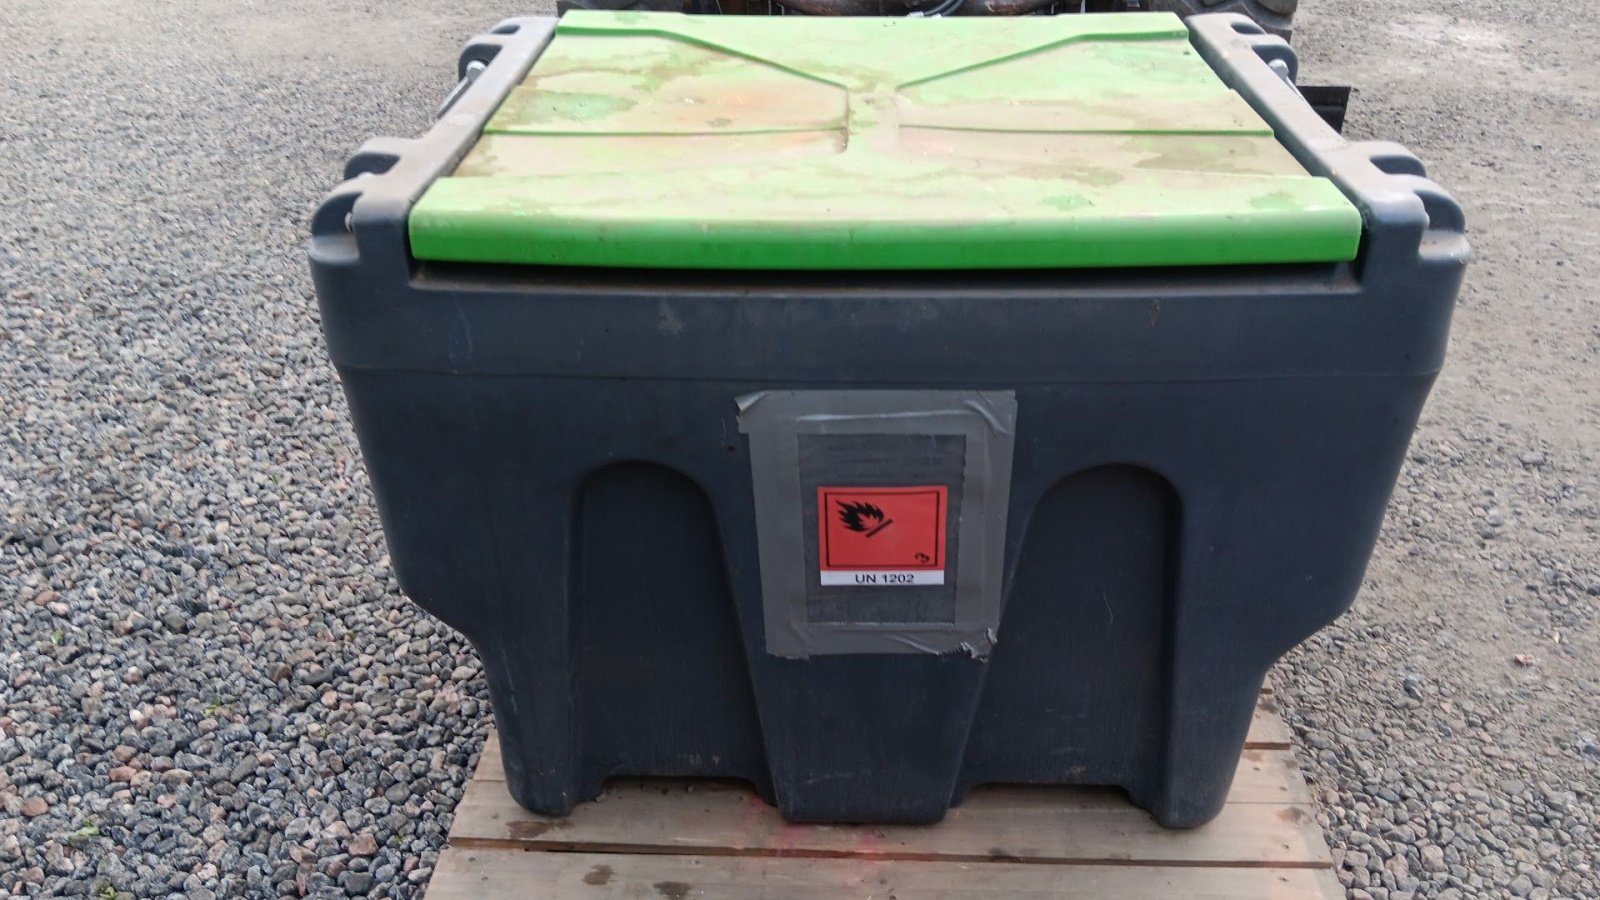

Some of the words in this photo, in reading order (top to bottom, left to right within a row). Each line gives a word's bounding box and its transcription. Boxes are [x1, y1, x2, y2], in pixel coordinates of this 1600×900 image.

[914, 552, 930, 563] 3
[855, 573, 876, 583] UN
[882, 573, 914, 583] 1202
